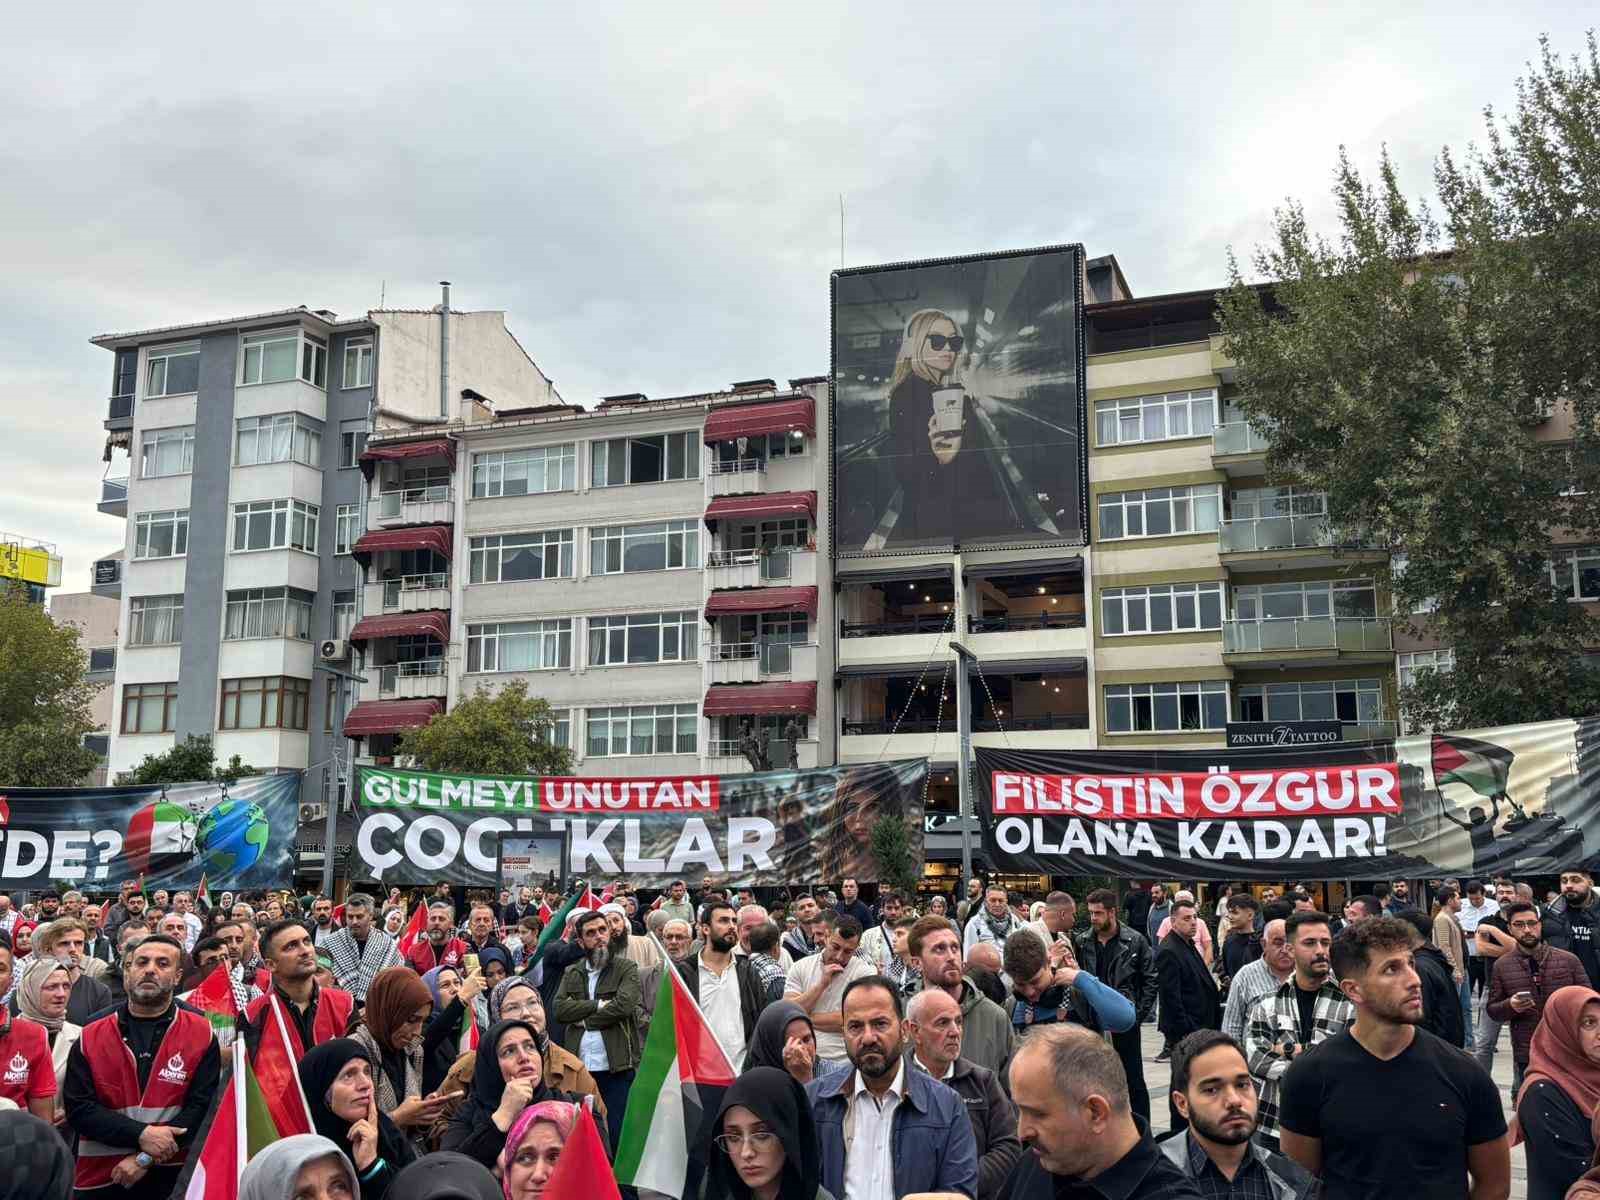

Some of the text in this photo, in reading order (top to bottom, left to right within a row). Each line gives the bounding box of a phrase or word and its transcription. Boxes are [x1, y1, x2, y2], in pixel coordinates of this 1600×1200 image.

[1231, 733, 1273, 744] ZENITH
[1289, 731, 1337, 742] TATTOO
[545, 780, 711, 809] UNUTAN
[0, 829, 123, 879] DE?
[357, 812, 777, 880] ÇOCKLAR
[995, 816, 1387, 859] OLANA KADAR!
